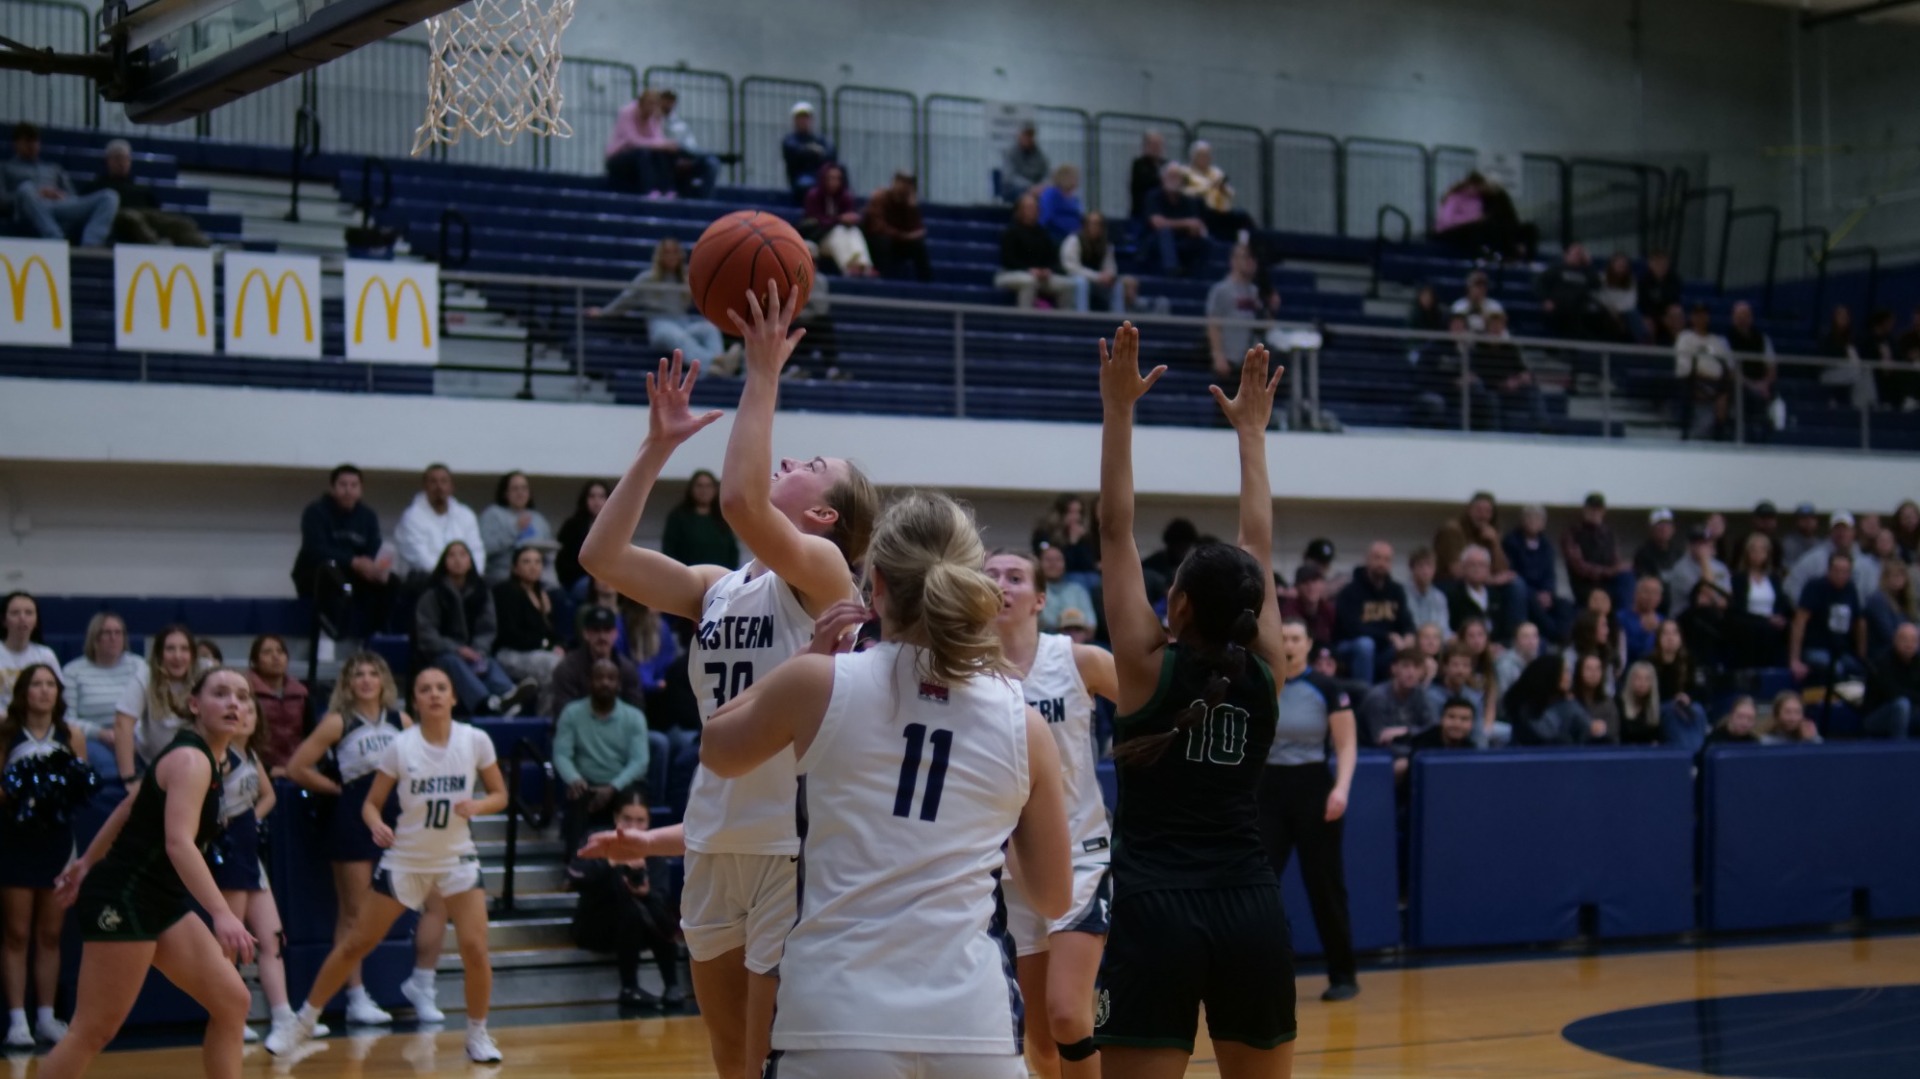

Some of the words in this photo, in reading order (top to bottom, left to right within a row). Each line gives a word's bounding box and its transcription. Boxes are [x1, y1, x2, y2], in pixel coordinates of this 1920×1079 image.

[123, 261, 207, 338] M
[234, 268, 314, 343] M
[353, 275, 432, 348] M
[697, 615, 774, 650] ASTERN
[704, 661, 754, 717] 30
[1028, 697, 1065, 724] RN
[1186, 699, 1250, 765] 10
[410, 773, 467, 795] EASTERN
[892, 722, 954, 823] 11
[425, 799, 450, 830] 10
